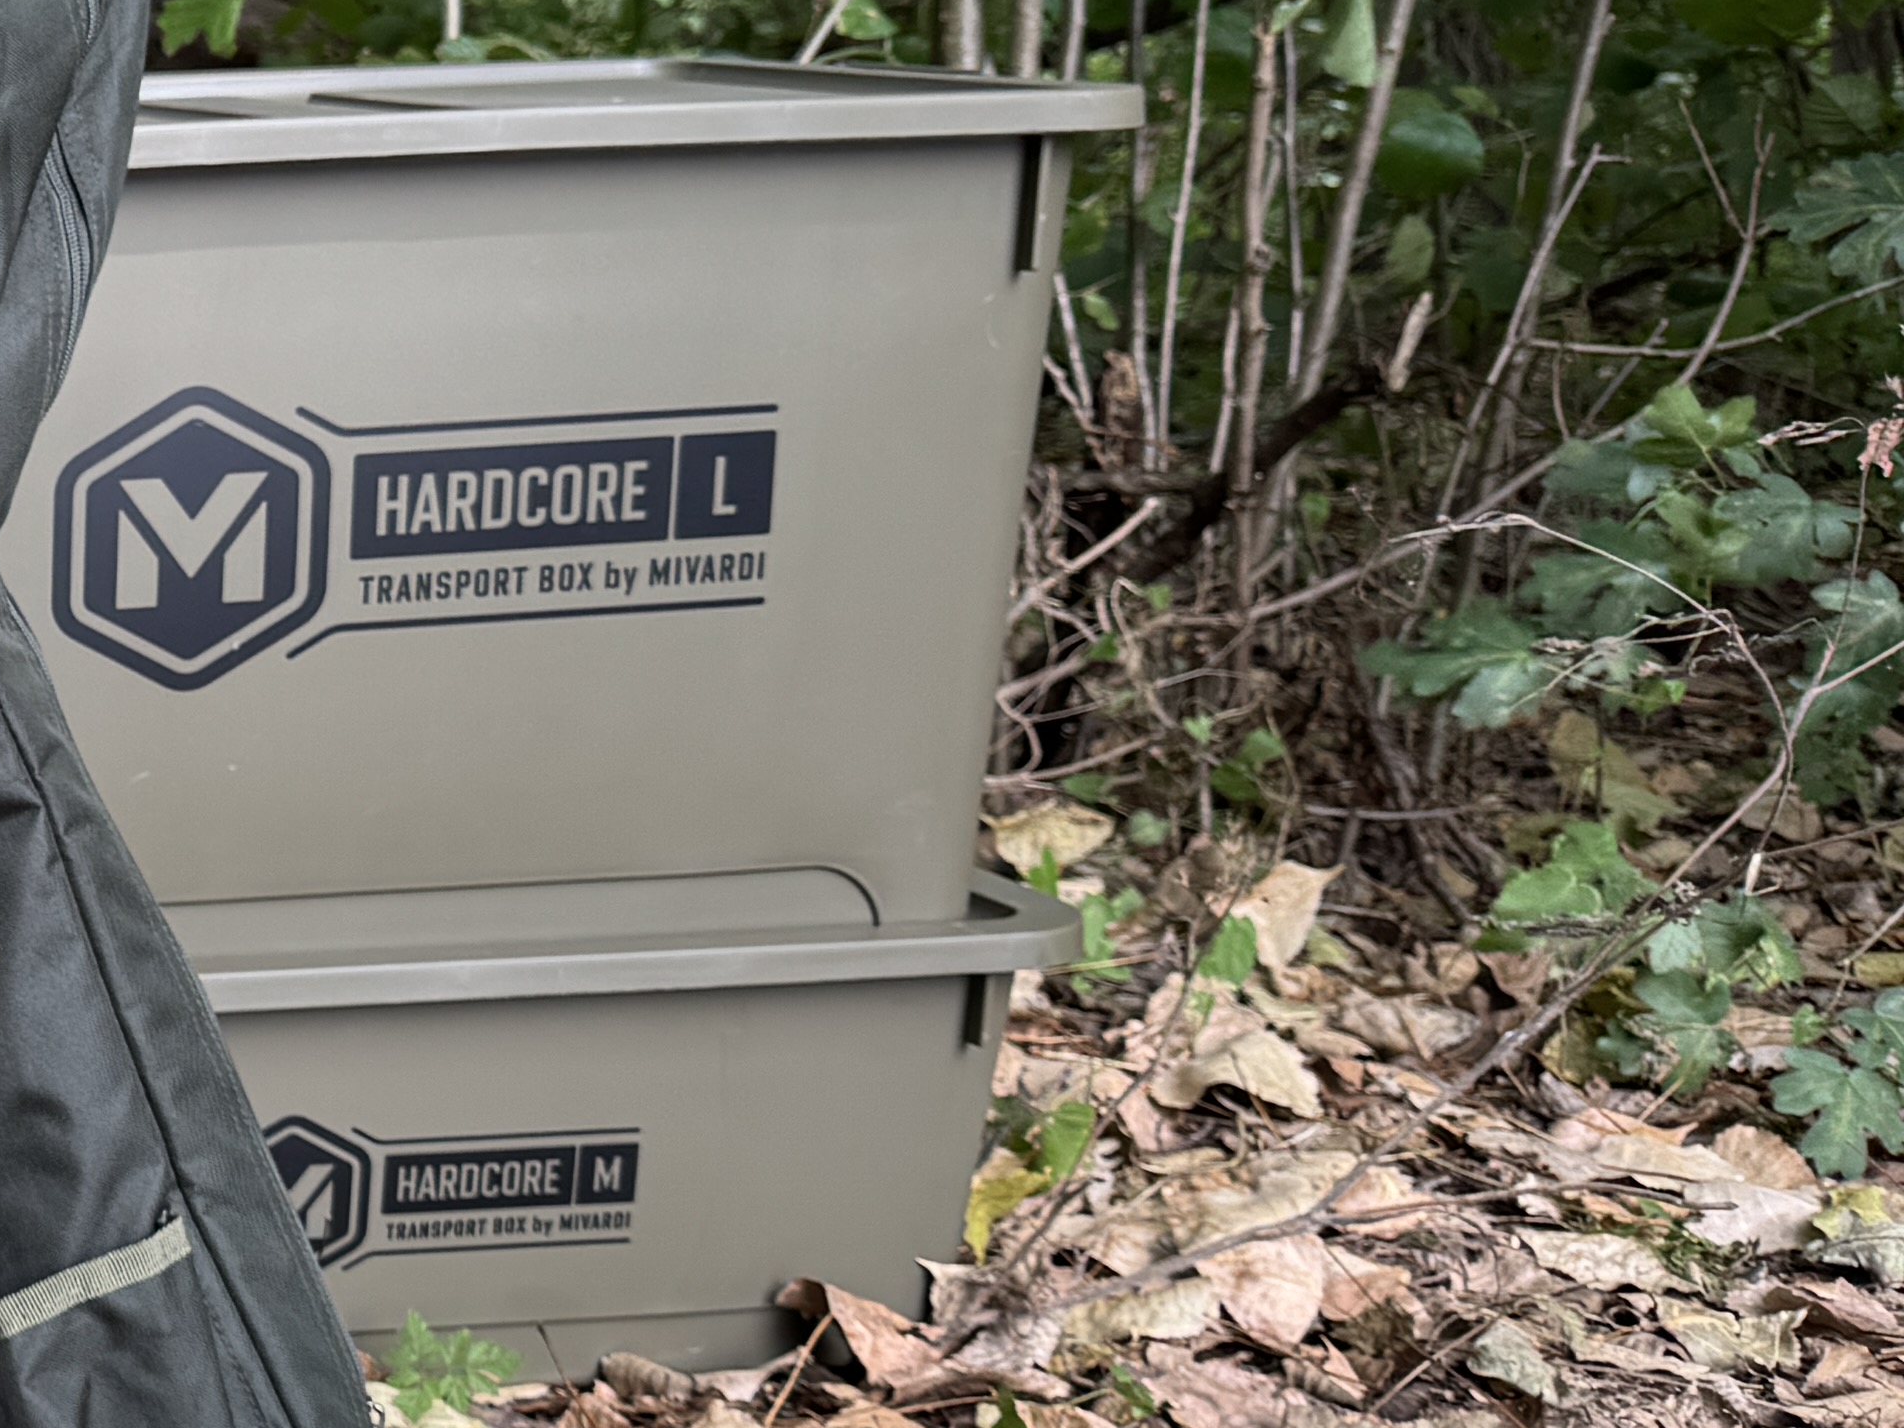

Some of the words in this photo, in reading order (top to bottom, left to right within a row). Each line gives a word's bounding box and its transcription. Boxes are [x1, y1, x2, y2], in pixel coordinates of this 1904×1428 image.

[374, 459, 651, 538] HARDCORE
[712, 455, 738, 516] L
[115, 470, 269, 611] M
[359, 566, 528, 605] TRANSPORT
[538, 562, 594, 594] BOX
[604, 561, 638, 596] by
[648, 552, 766, 587] MIVARDI
[395, 1158, 563, 1203] HARDCORE
[592, 1155, 623, 1193] M
[386, 1218, 488, 1241] TRANSPORT
[493, 1216, 529, 1235] BOX
[532, 1215, 554, 1237] by
[559, 1211, 632, 1232] MIVARDI
